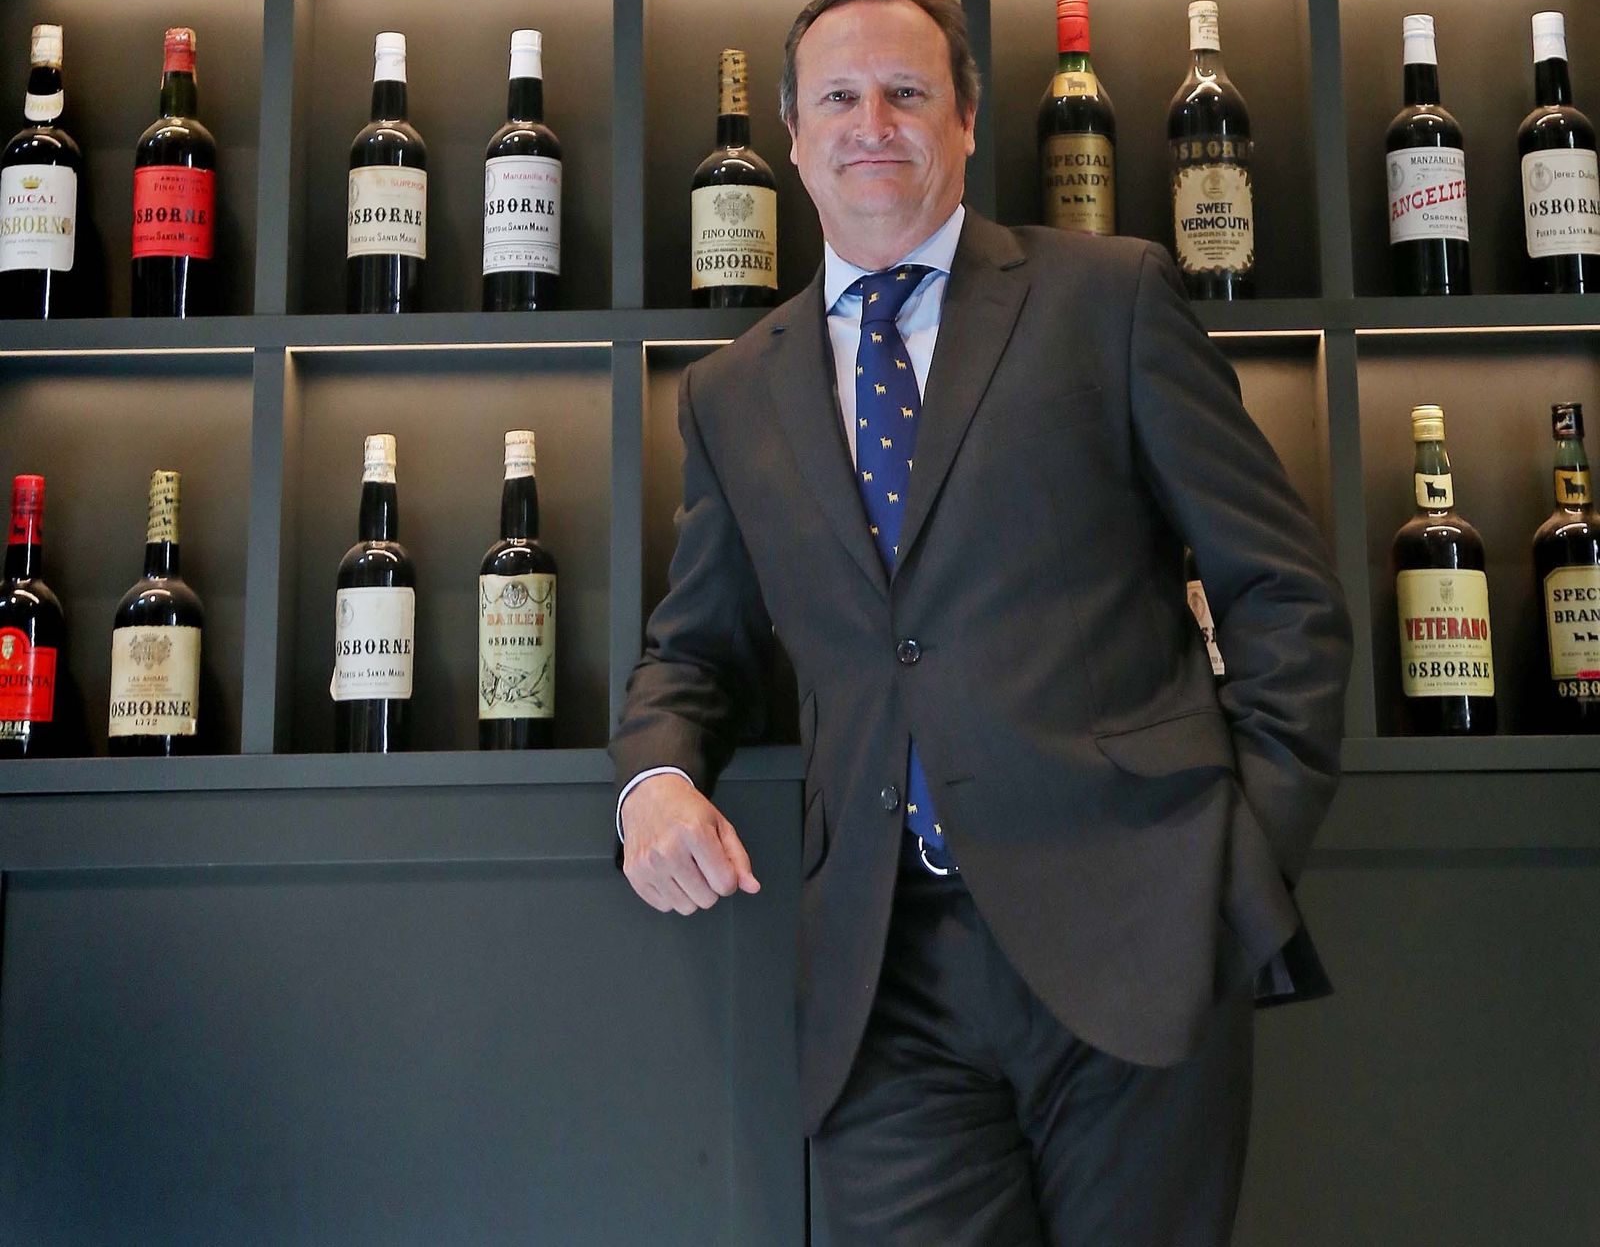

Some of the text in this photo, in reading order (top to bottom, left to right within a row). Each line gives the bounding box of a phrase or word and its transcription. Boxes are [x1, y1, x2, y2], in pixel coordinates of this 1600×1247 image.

[9, 194, 57, 205] DUCAL
[1196, 202, 1233, 214] SWEET
[134, 207, 207, 227] SBORNE
[1181, 216, 1250, 232] VERMOUTH
[508, 221, 529, 231] SANTA
[529, 222, 549, 233] MARIA
[702, 228, 766, 241] FINO QUINTA
[376, 231, 398, 241] SANTA
[399, 233, 418, 244] MARIA
[493, 253, 549, 262] ESTEBAN
[696, 254, 773, 273] OSBORNE
[723, 271, 746, 279] 1772
[1553, 587, 1600, 602] SPEC
[486, 609, 545, 626] BAILÉN
[1554, 608, 1600, 624] BRAN
[1405, 617, 1489, 641] VETERANO
[336, 639, 412, 657] OSBORNE
[488, 636, 544, 646] OSBORNE
[366, 667, 386, 677] SANTA
[1409, 661, 1490, 678] OSBORNE
[1559, 681, 1600, 697] OSBO
[111, 700, 191, 718] OSBORNE
[0, 720, 31, 734] ORNE
